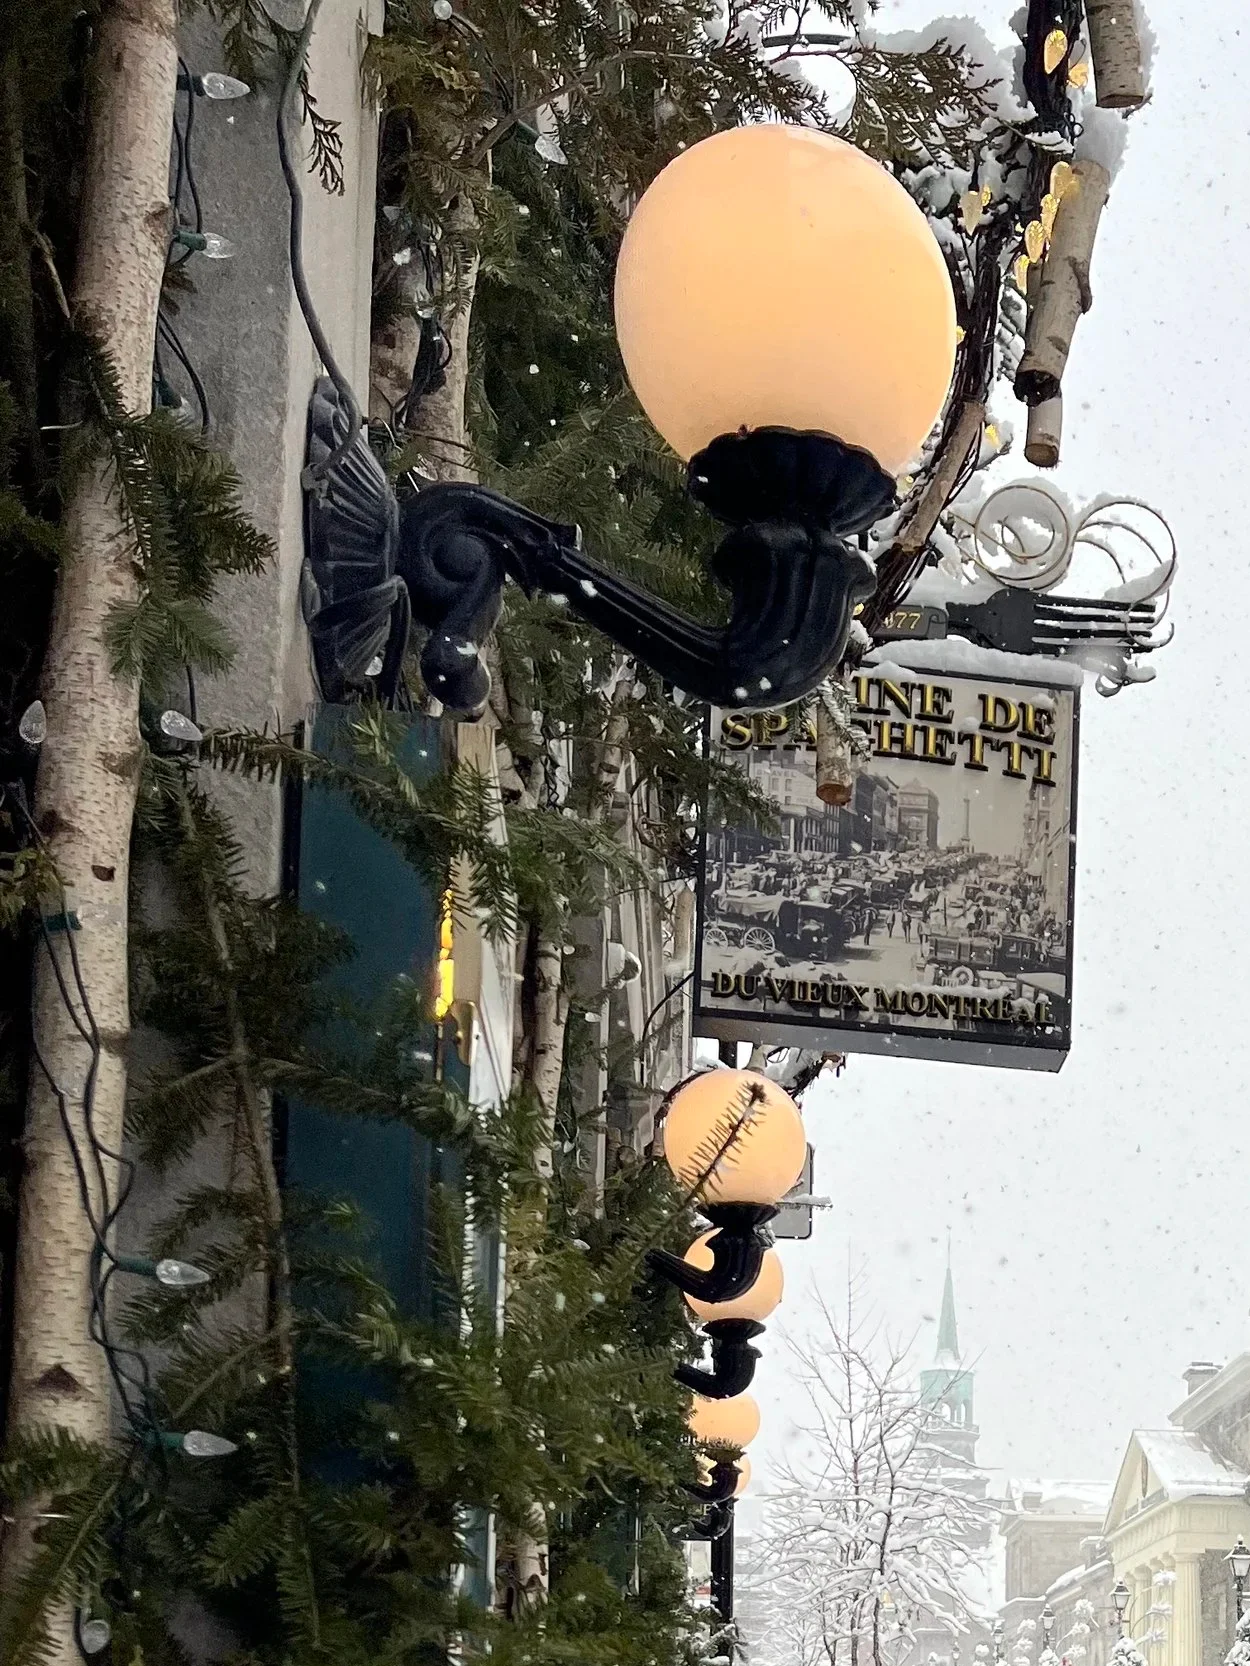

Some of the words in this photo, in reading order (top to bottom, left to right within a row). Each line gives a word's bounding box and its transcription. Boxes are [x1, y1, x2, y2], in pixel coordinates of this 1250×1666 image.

[978, 693, 1056, 745] DE
[721, 712, 1057, 788] SPHETTI
[711, 972, 761, 998] DU
[764, 977, 869, 1011] VIEUX
